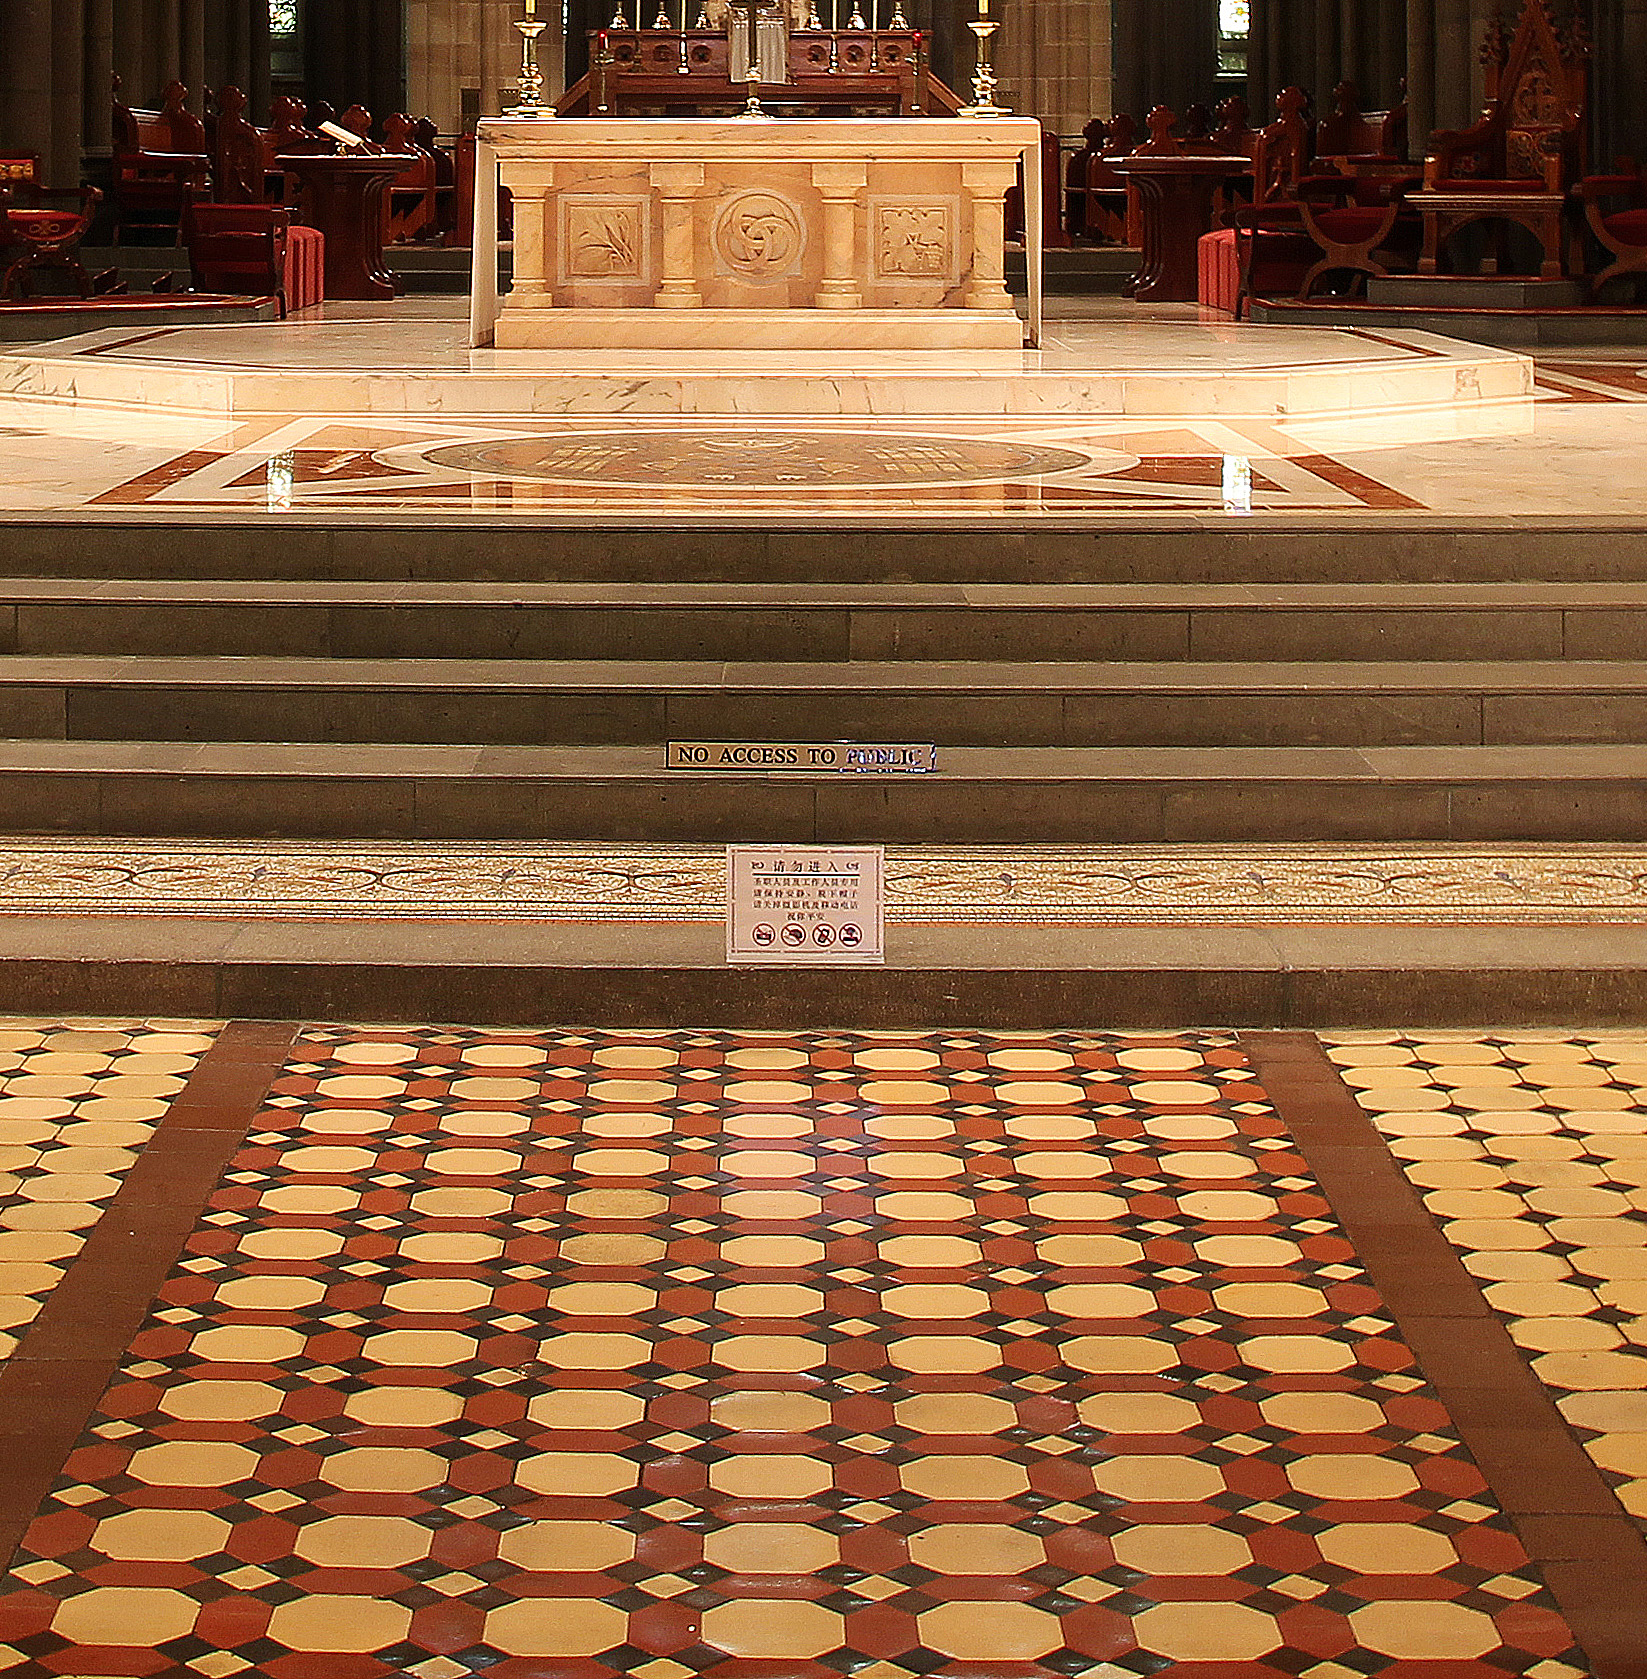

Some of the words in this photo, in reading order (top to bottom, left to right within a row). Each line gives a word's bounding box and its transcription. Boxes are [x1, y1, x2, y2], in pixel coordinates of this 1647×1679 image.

[678, 746, 709, 764] NO
[719, 747, 797, 765] ACCESS
[808, 748, 836, 765] TO
[846, 749, 923, 766] PUBLIC
[773, 860, 839, 873] 请勿进入
